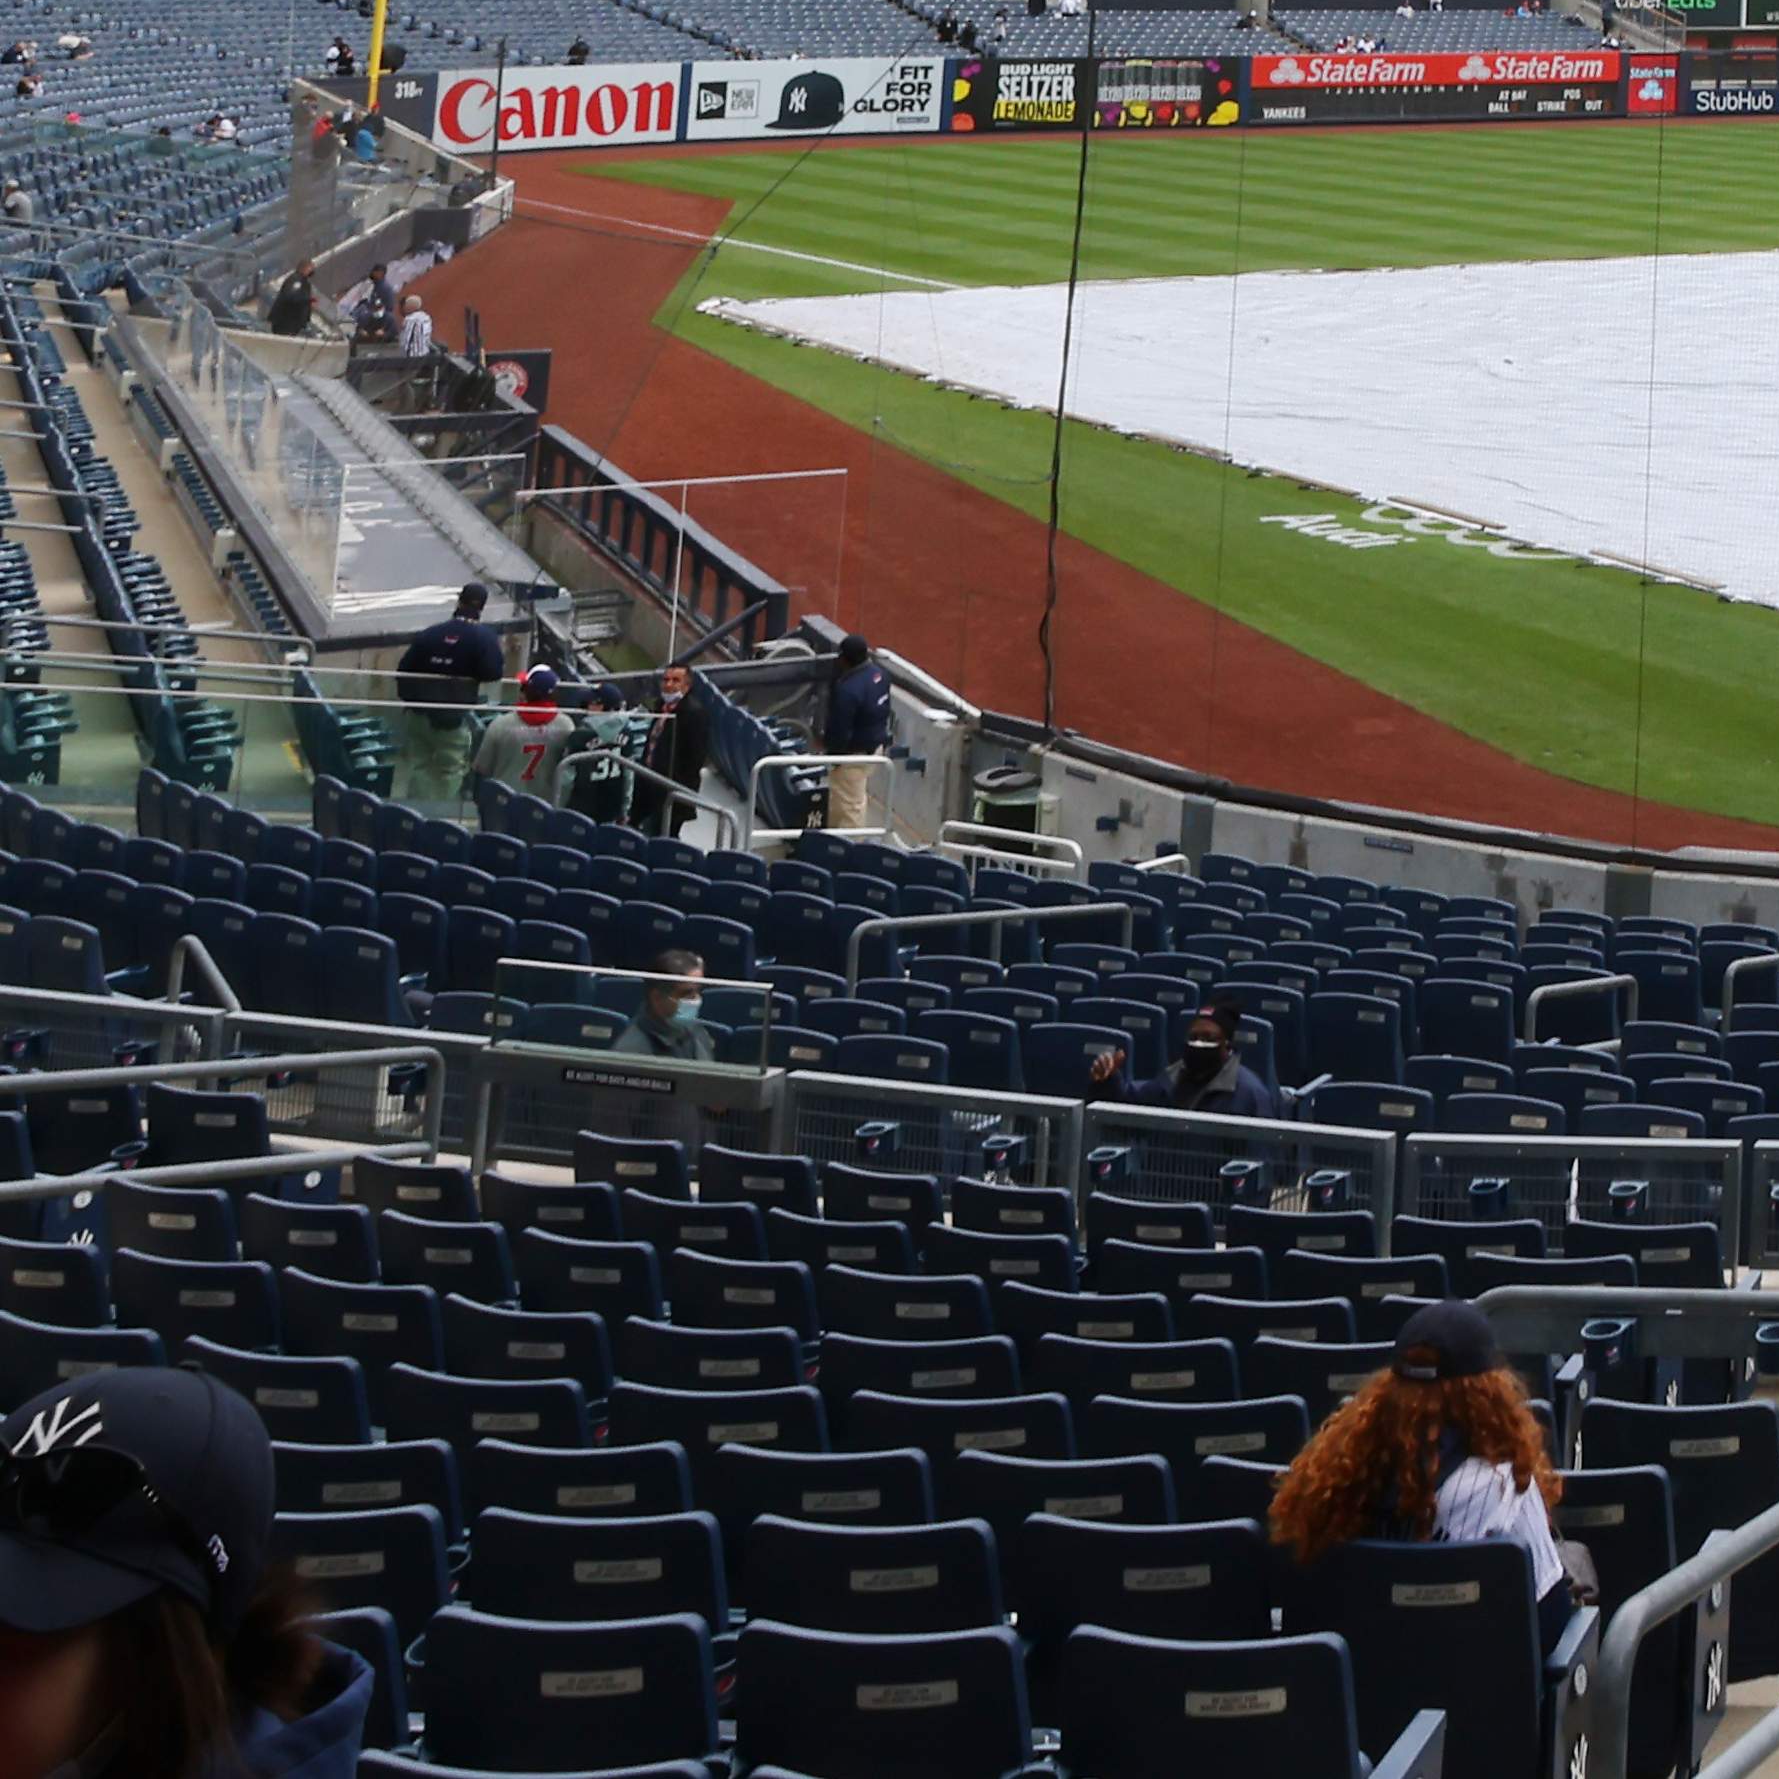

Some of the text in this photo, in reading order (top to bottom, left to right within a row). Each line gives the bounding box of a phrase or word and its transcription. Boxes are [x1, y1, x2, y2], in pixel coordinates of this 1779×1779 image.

[900, 66, 934, 80] FIT
[1000, 63, 1076, 76] BUD LIGHT
[886, 82, 932, 96] FOR
[997, 75, 1076, 101] SELTZER
[731, 89, 755, 102] NEW
[1696, 90, 1775, 114] StubHub
[438, 77, 675, 144] Canon
[730, 100, 755, 111] ERA
[853, 98, 931, 113] GLORY
[993, 100, 1075, 121] LEMONADE
[1488, 100, 1603, 113] BALL STRIKE OUT
[1261, 107, 1307, 120] YANKEES
[1259, 513, 1418, 550] Audi
[520, 743, 546, 781] 7
